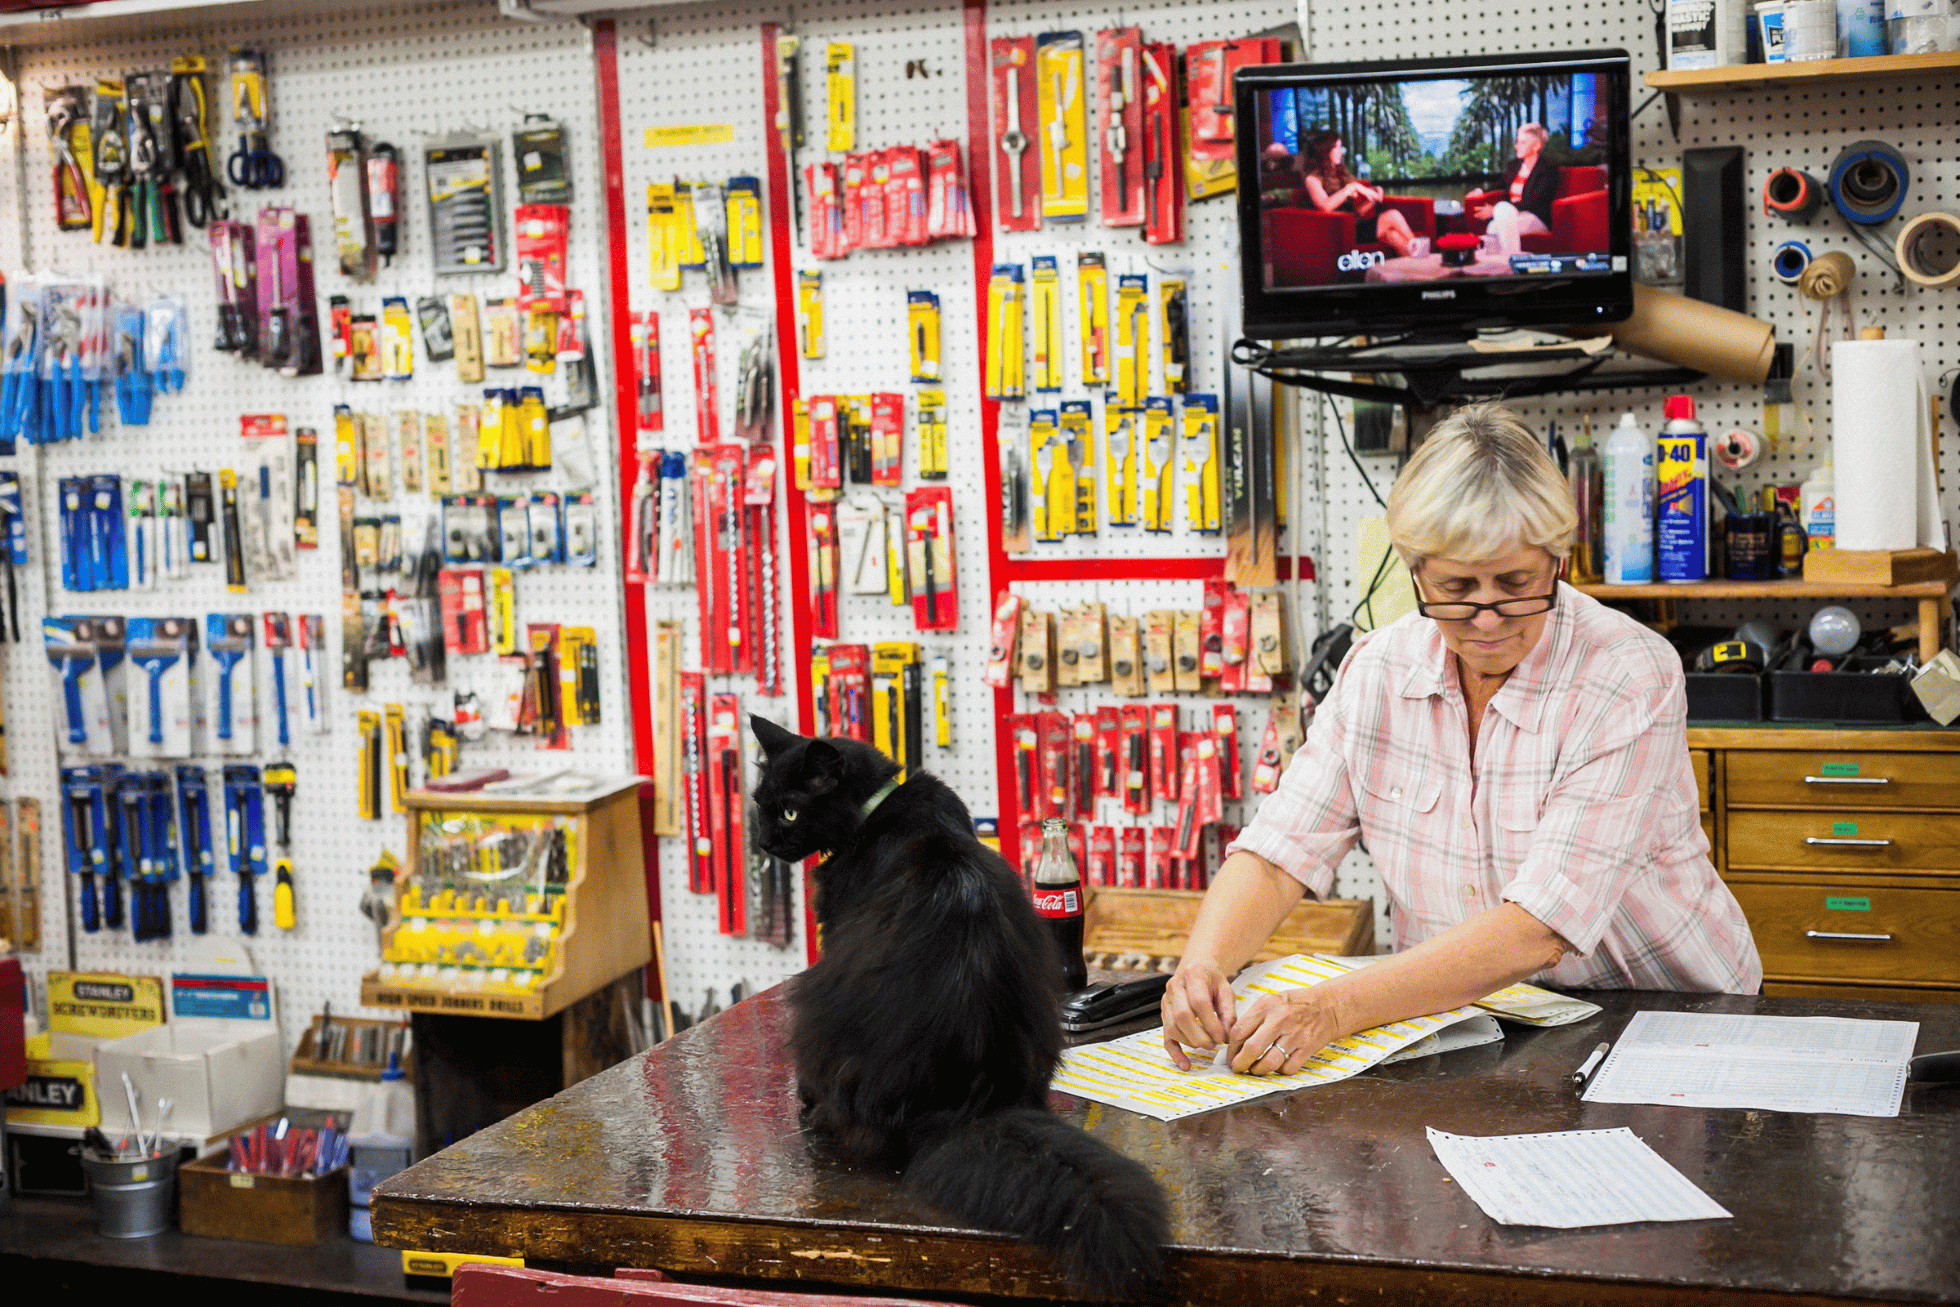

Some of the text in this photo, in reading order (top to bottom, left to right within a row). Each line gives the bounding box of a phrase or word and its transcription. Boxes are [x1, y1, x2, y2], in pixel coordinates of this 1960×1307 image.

[1337, 249, 1385, 272] ellen
[1422, 290, 1456, 300] PHILIPS
[1658, 444, 1690, 462] D-40
[1232, 427, 1243, 500] VULCAN
[77, 985, 130, 1000] STANLEY
[6, 1083, 77, 1105] ANLEY
